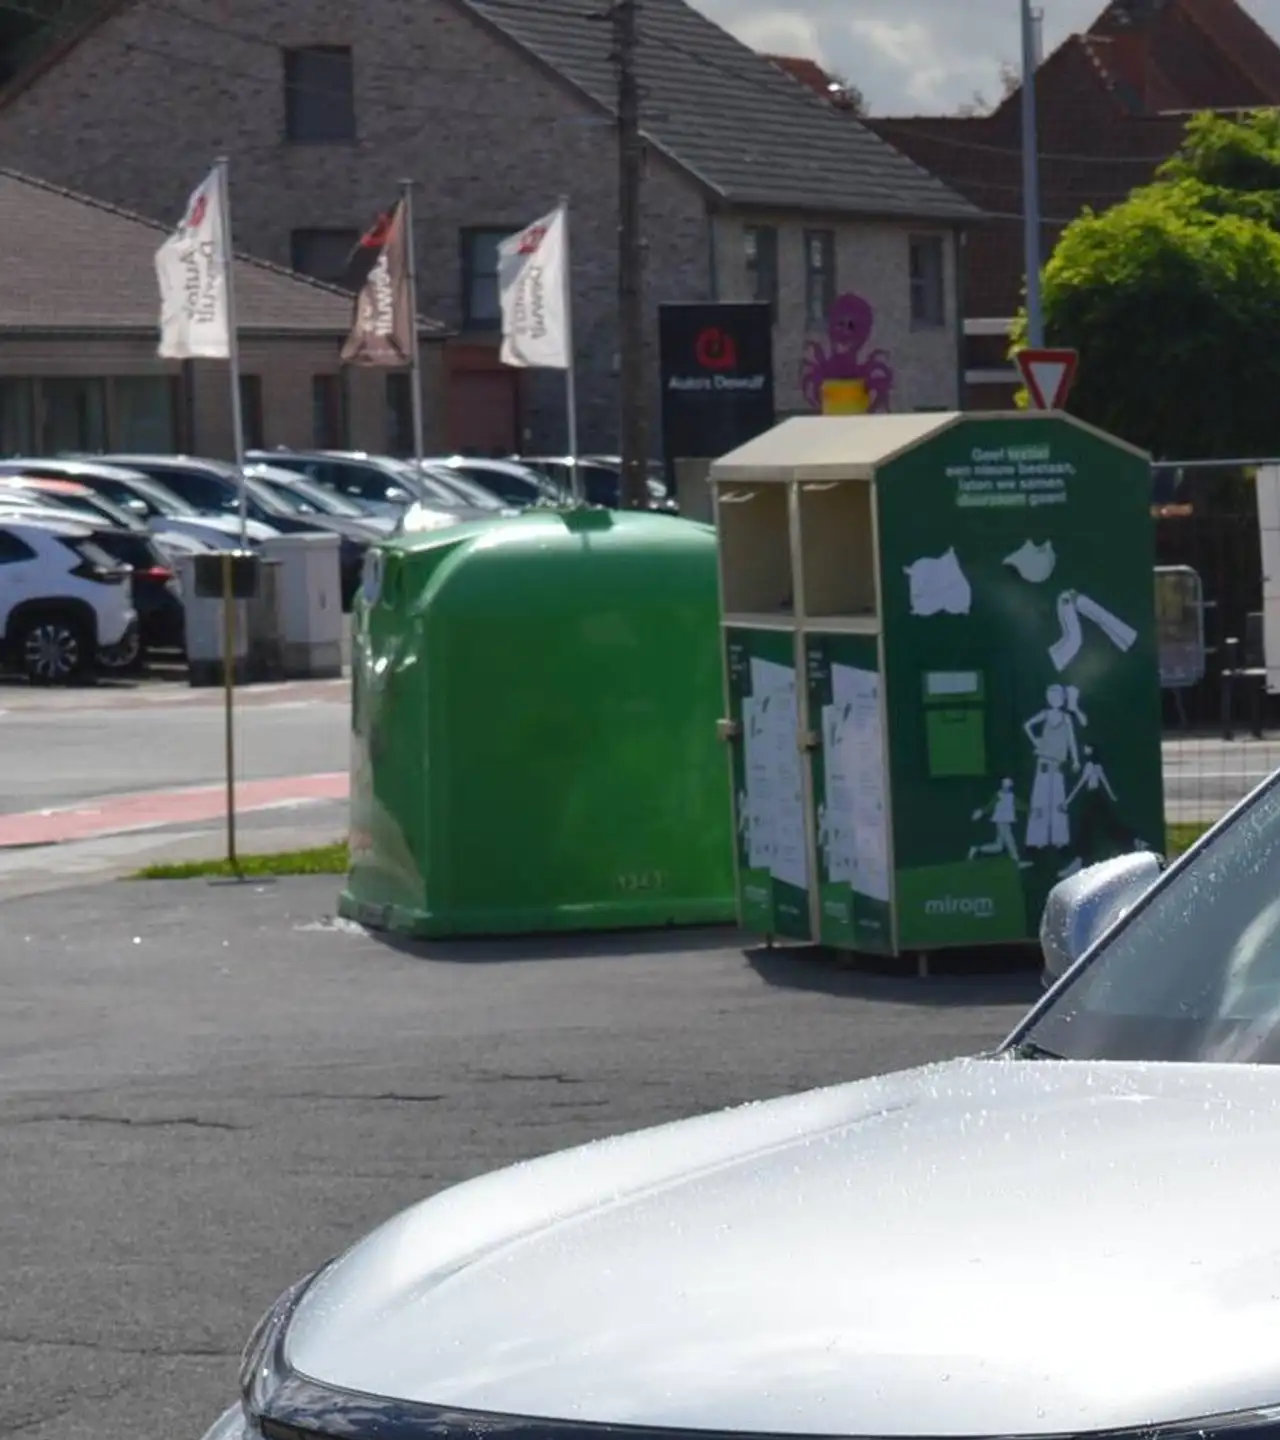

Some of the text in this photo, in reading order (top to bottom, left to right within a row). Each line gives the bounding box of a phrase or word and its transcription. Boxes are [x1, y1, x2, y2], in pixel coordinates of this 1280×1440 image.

[996, 481, 1016, 490] we
[1019, 479, 1065, 490] samen
[924, 894, 994, 917] mirom
